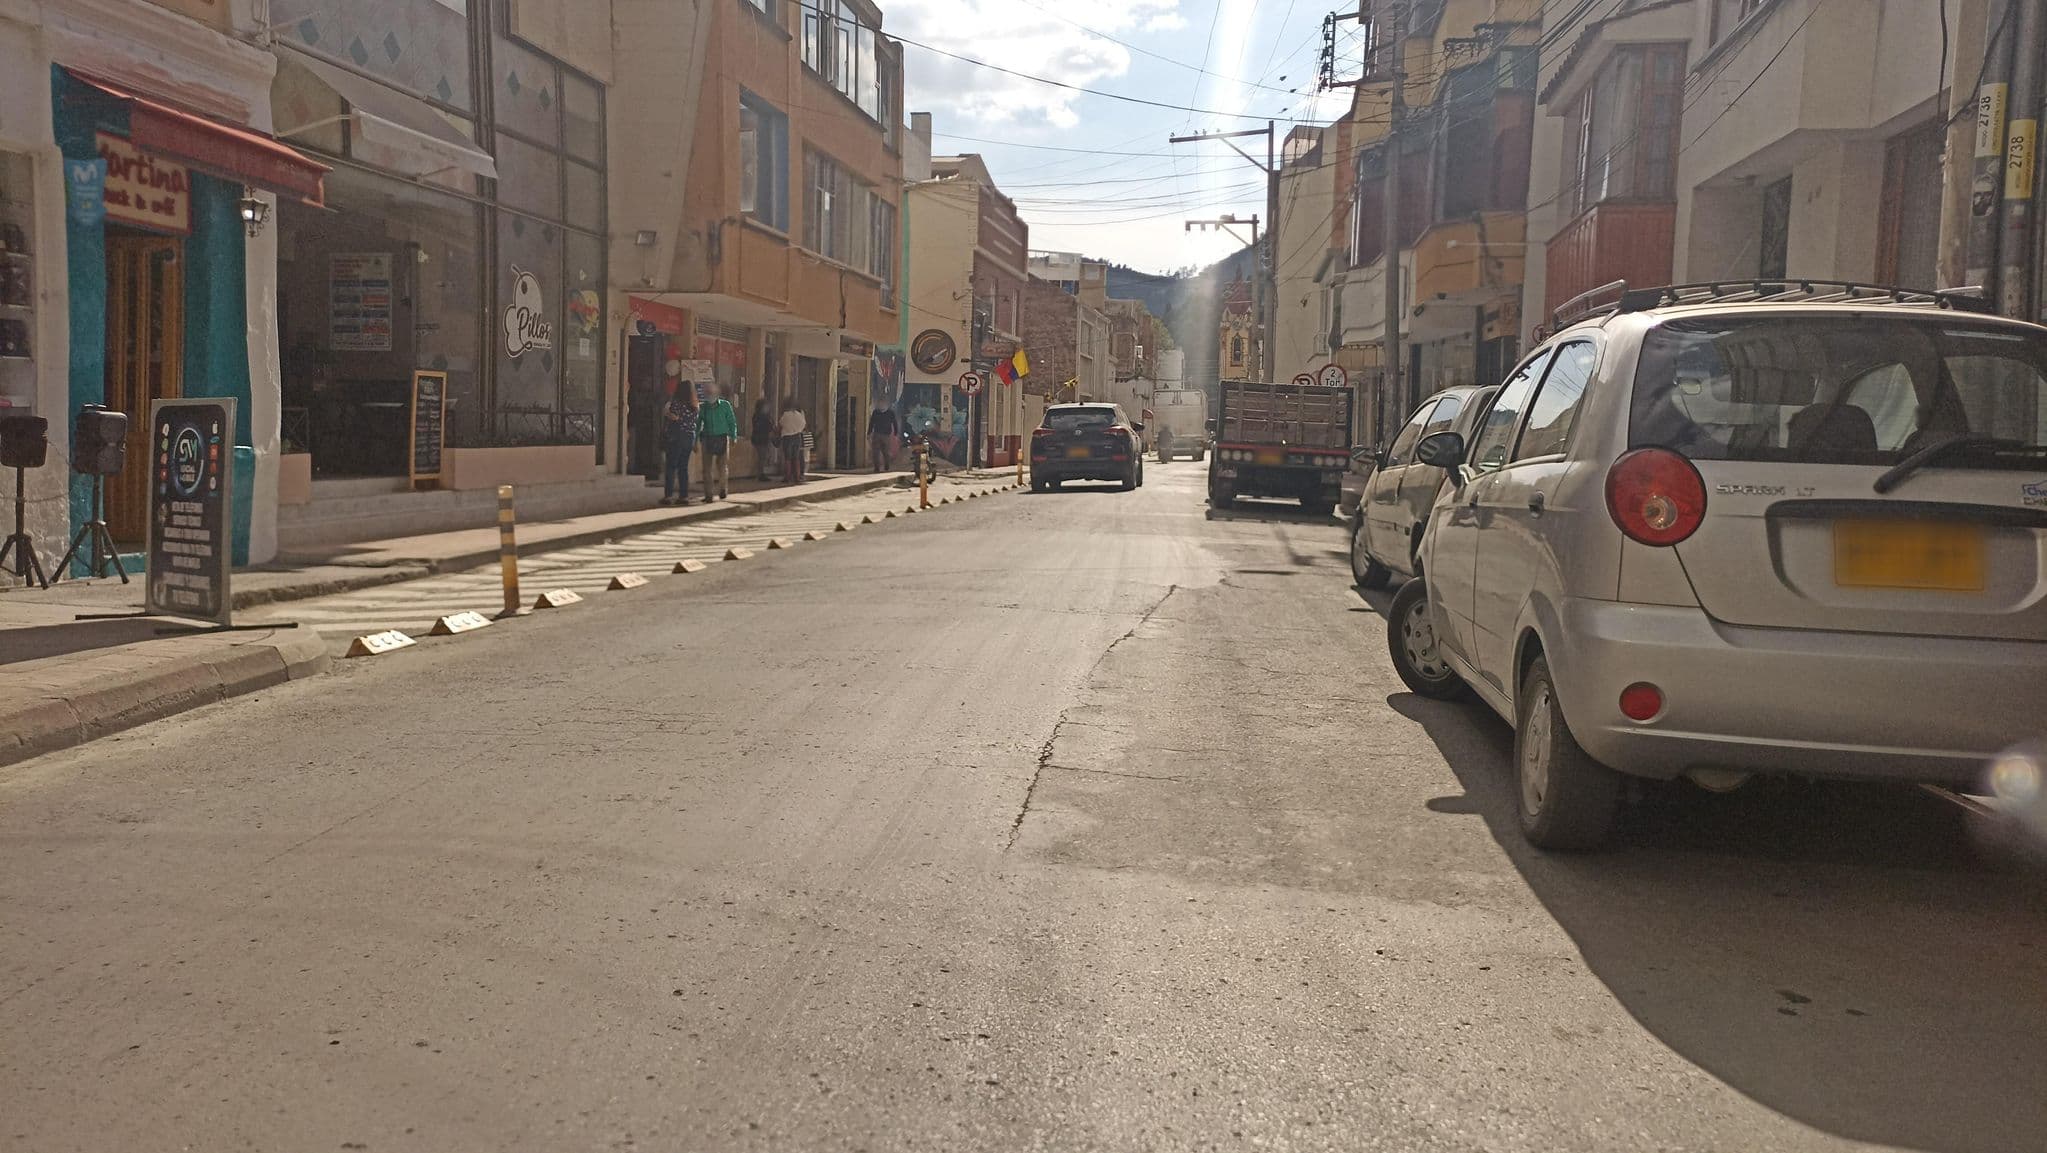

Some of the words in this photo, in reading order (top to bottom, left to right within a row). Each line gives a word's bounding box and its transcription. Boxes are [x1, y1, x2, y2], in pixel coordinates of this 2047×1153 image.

[1979, 95, 1991, 128] 2738
[2009, 135, 2024, 169] 2738
[516, 306, 551, 343] Pillos
